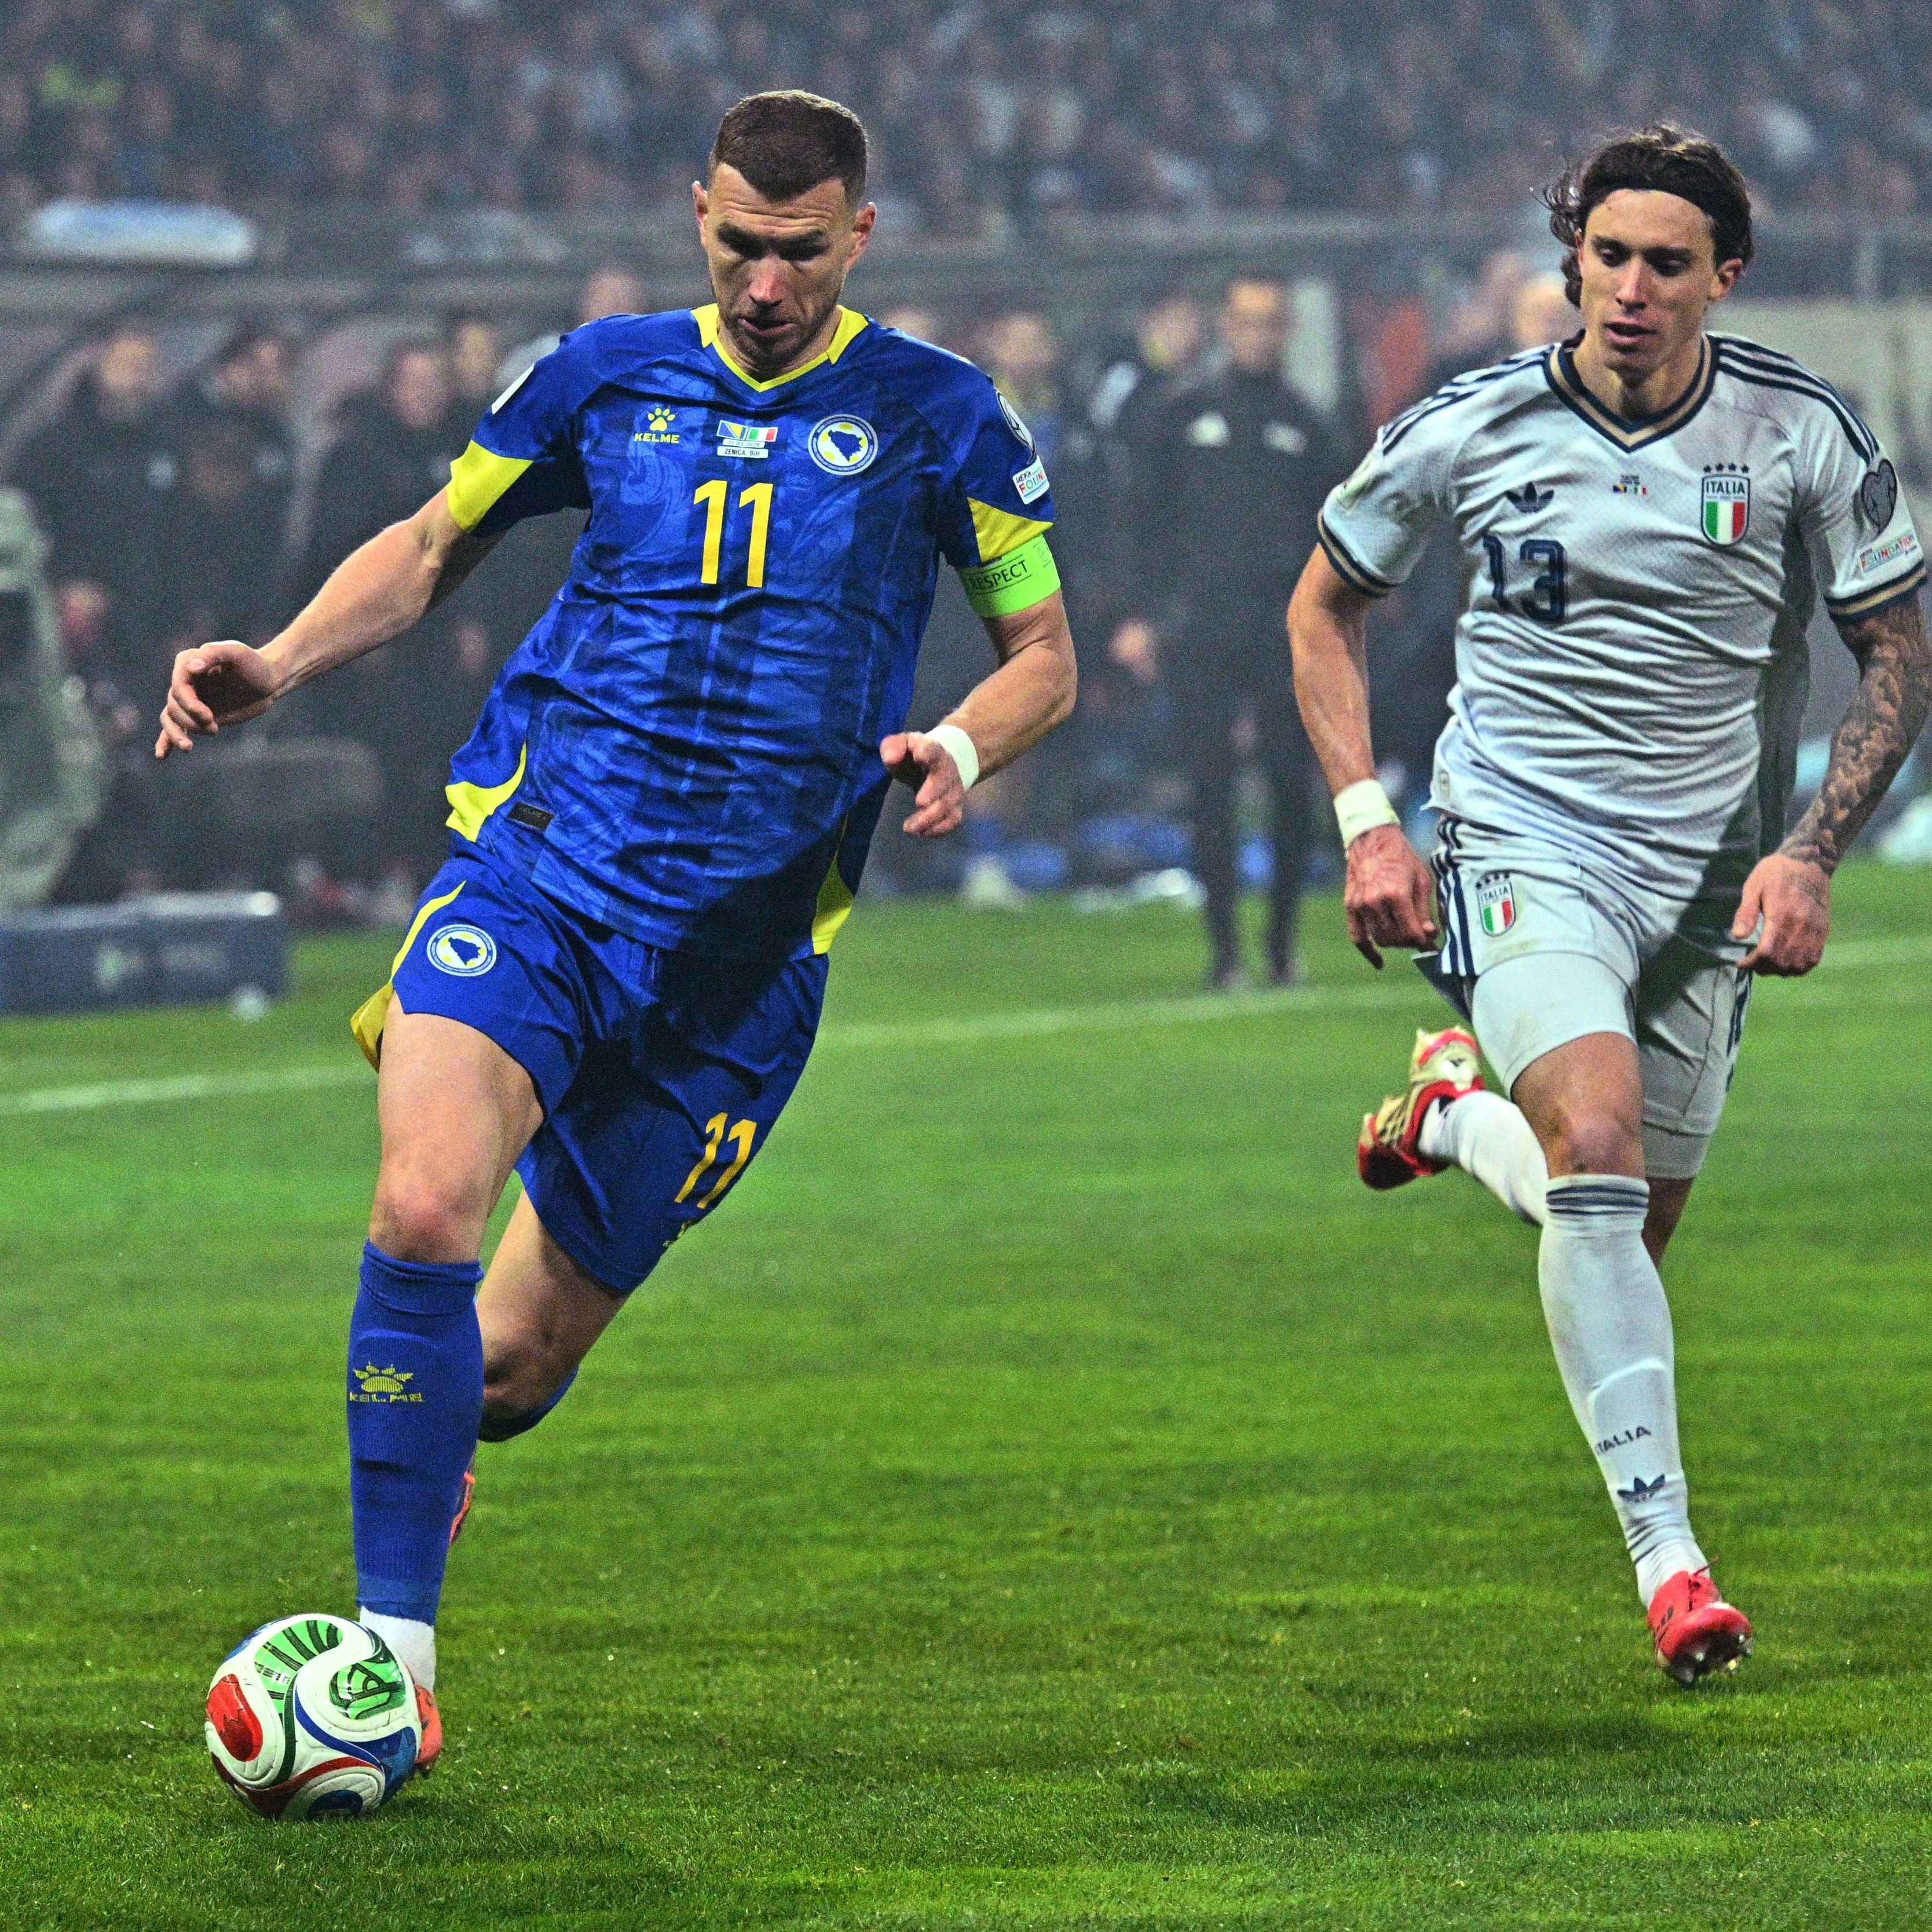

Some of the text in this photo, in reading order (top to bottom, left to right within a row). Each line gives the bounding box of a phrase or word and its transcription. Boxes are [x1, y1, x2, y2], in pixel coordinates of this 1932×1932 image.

[634, 433, 680, 444] KELME
[1016, 471, 1031, 484] UEFA
[1706, 480, 1745, 495] ITALIA
[693, 480, 773, 588] 11
[969, 559, 1028, 590] RESPECT
[1483, 533, 1567, 622] 13
[1480, 885, 1509, 902] ITALIA
[674, 1111, 757, 1209] 11
[349, 1391, 423, 1403] KELME
